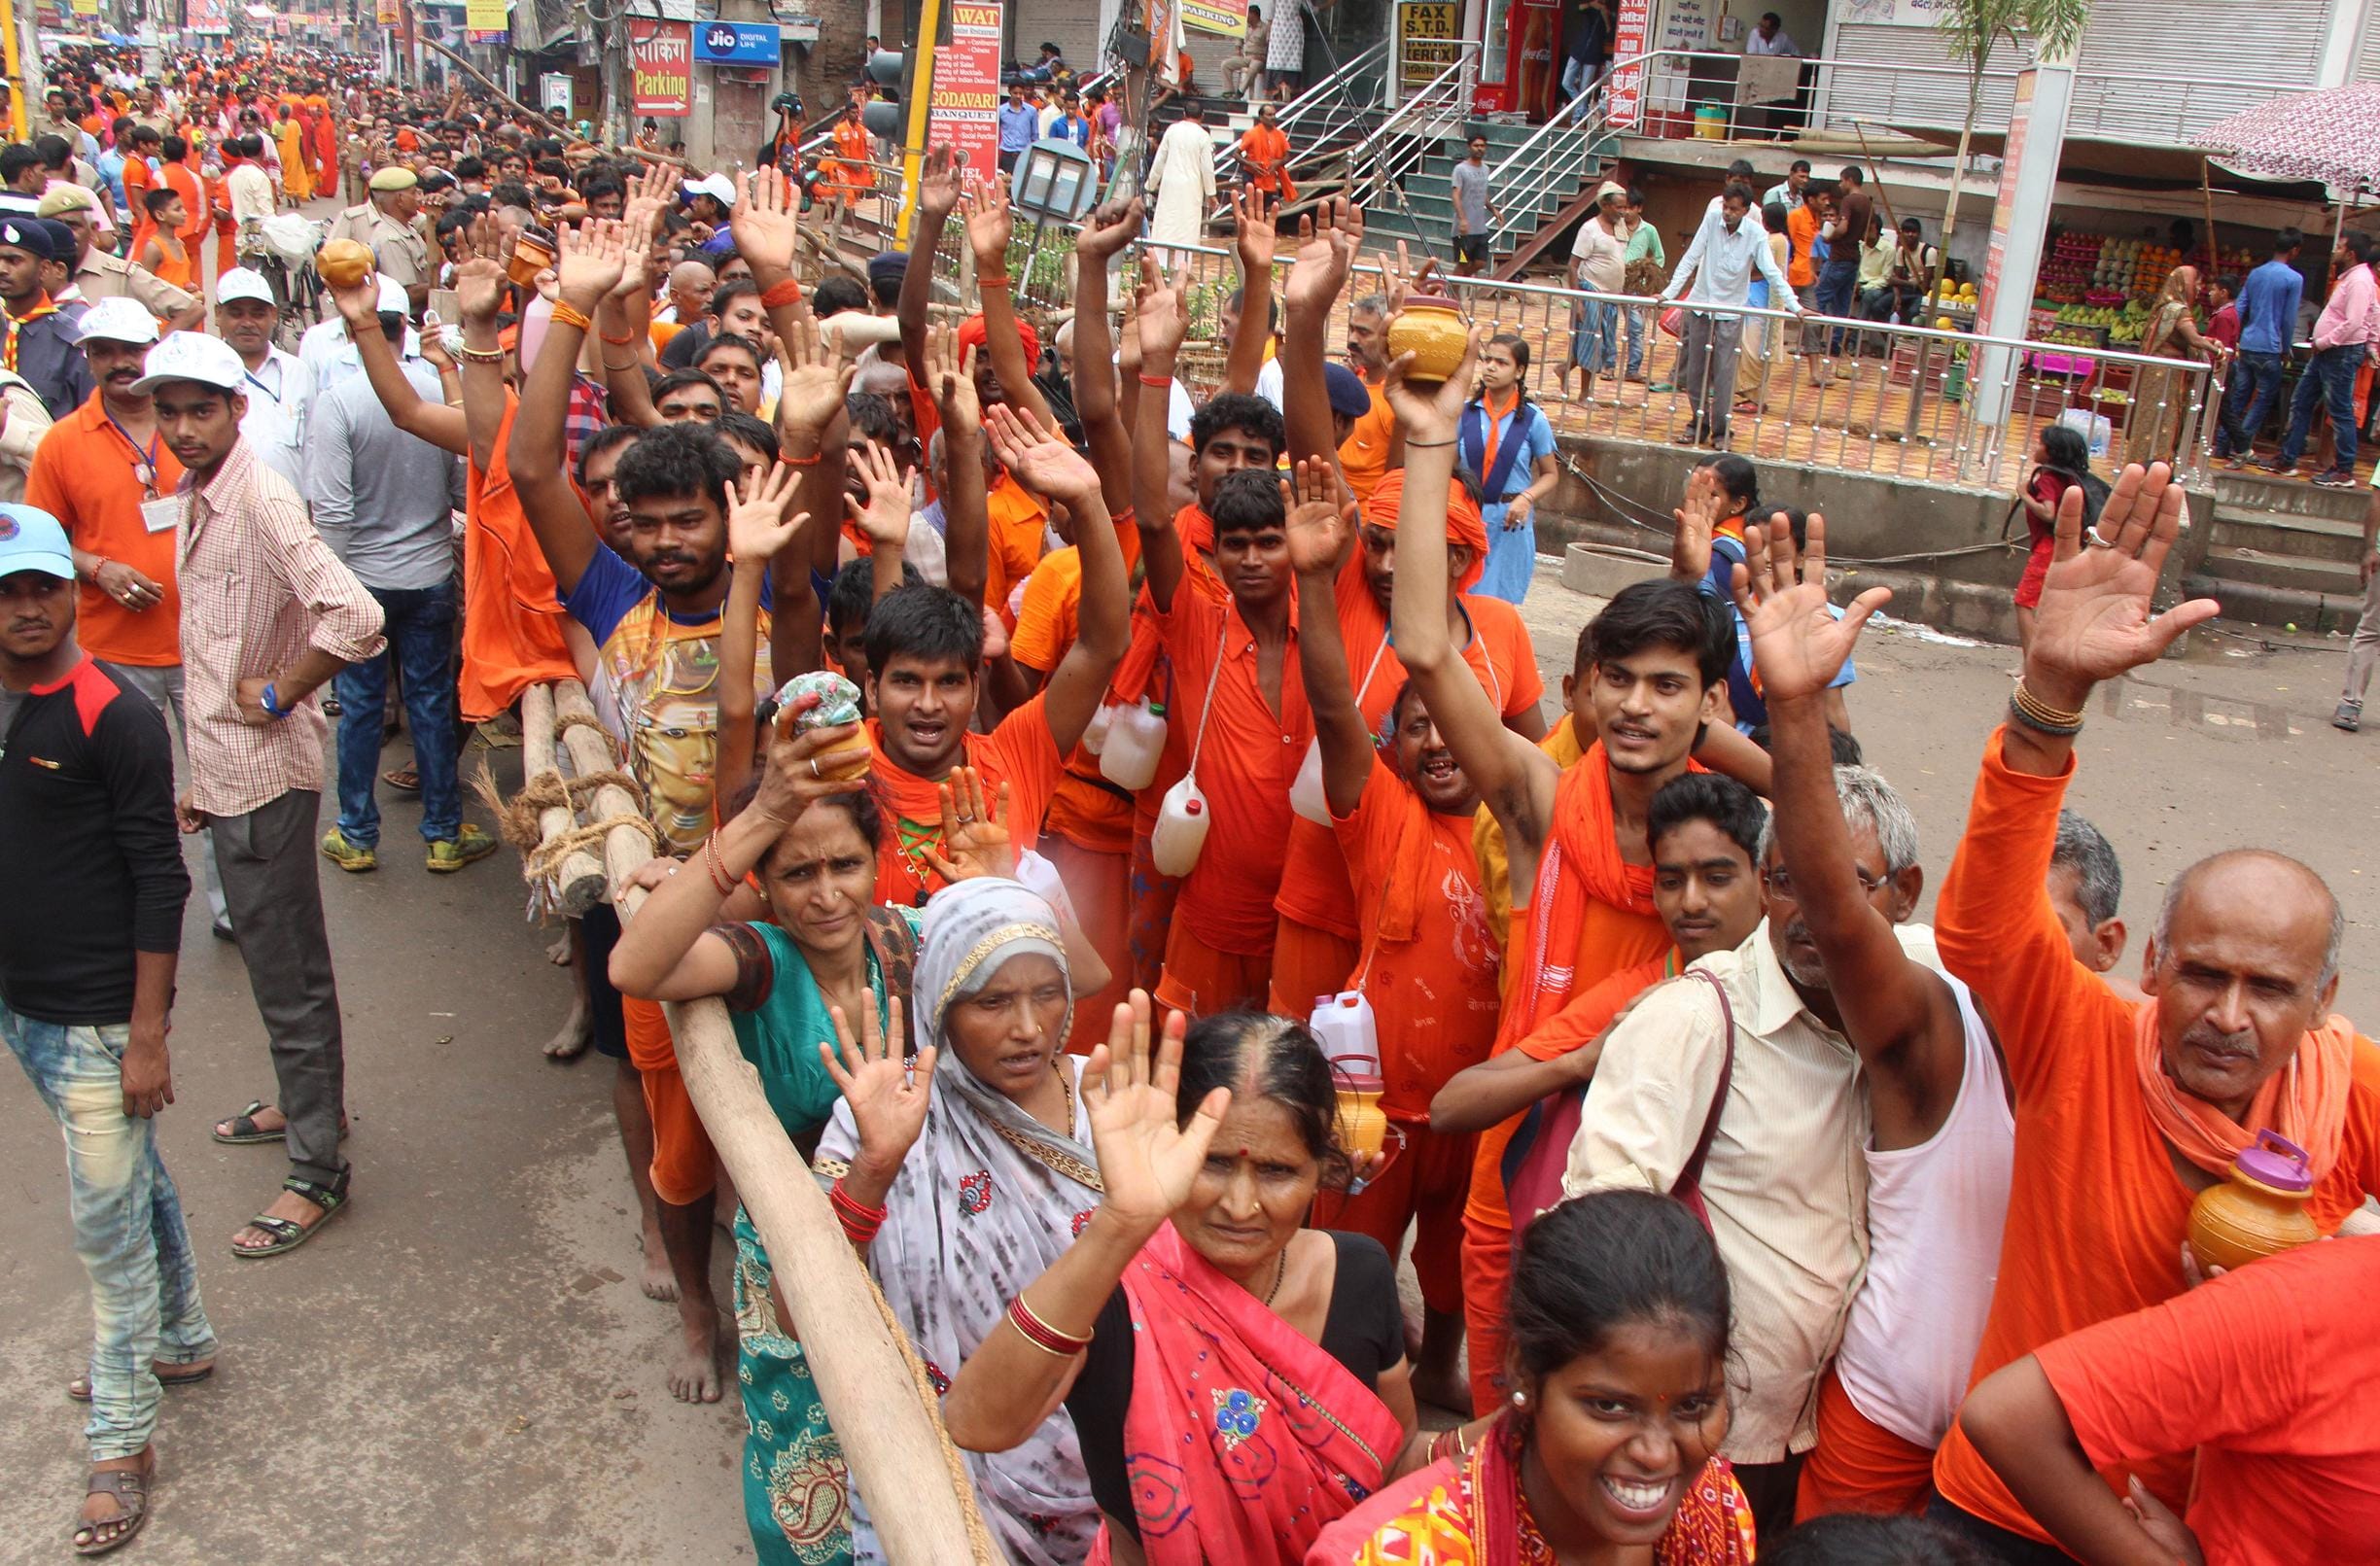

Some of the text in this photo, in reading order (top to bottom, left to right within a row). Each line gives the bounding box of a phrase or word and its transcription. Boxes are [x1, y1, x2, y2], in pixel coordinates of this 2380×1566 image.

[1182, 4, 1236, 26] PARKING
[1410, 6, 1446, 19] FAX
[1406, 20, 1450, 33] S.T.D.
[708, 30, 735, 48] Jio
[740, 33, 768, 43] DIGITAL
[635, 69, 688, 103] Parking
[931, 90, 998, 109] GODAVARI
